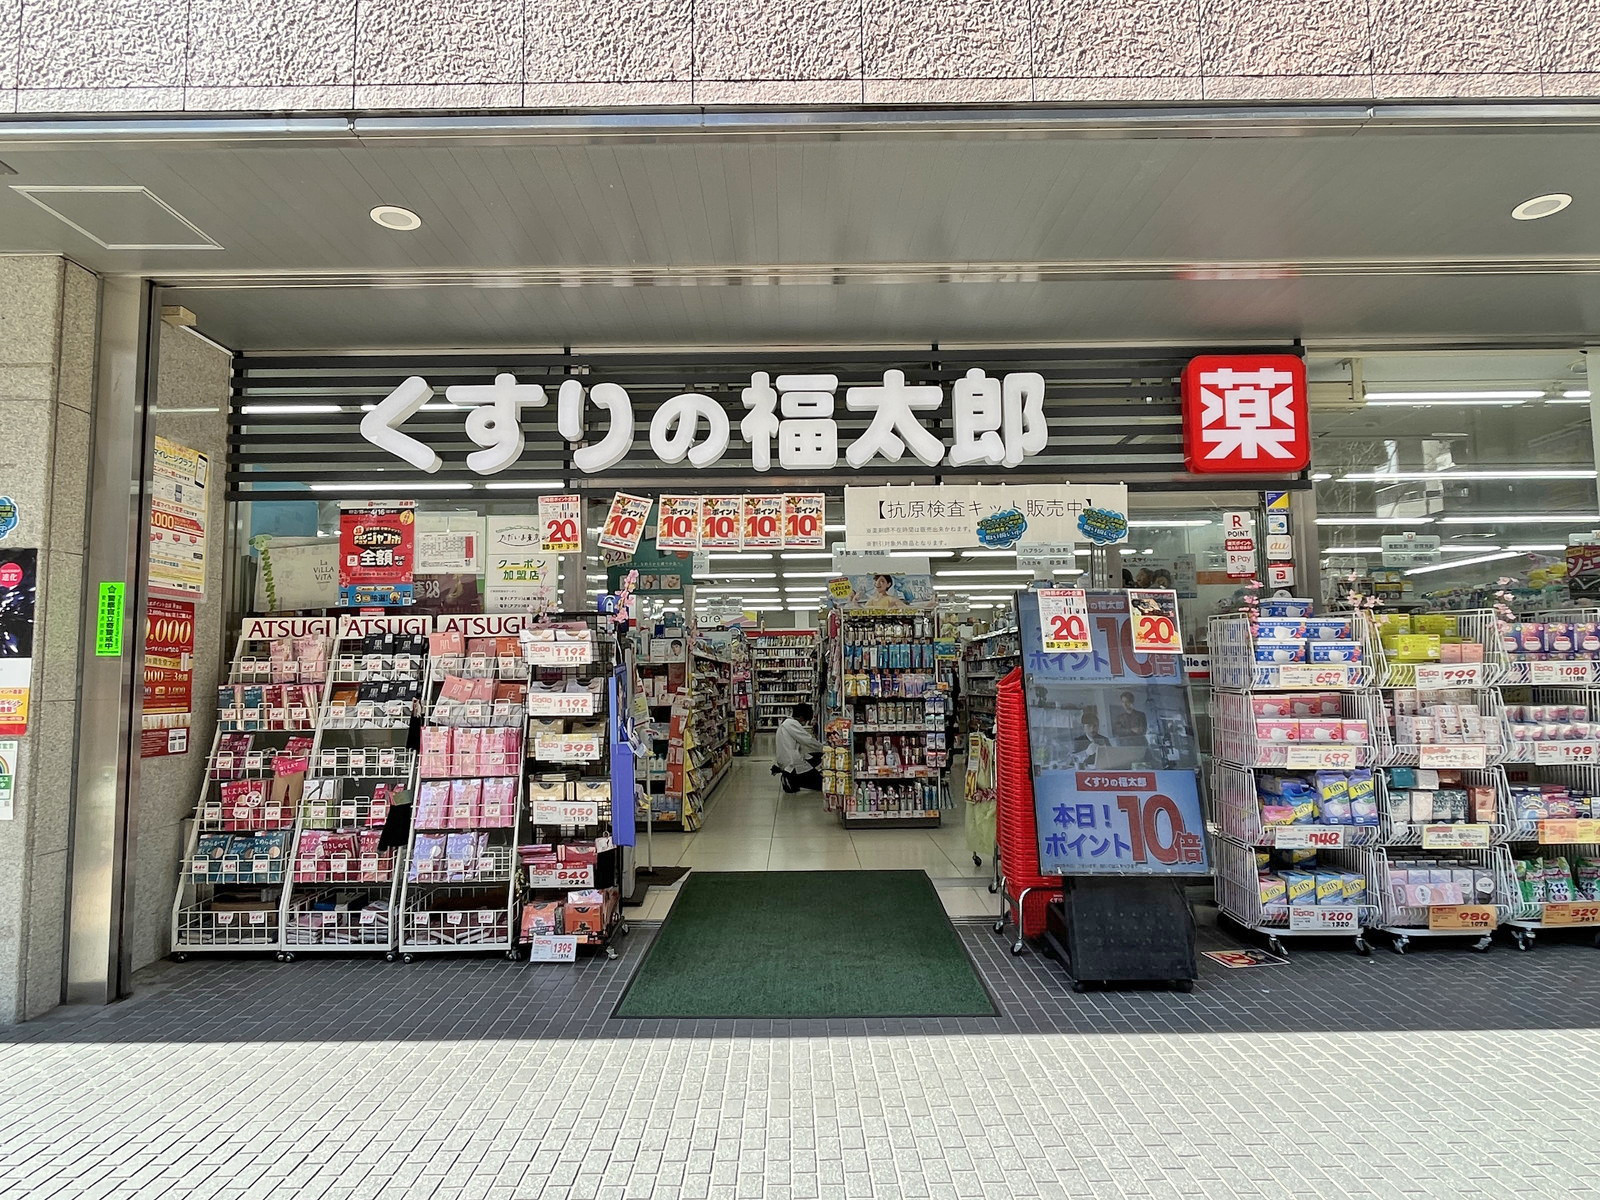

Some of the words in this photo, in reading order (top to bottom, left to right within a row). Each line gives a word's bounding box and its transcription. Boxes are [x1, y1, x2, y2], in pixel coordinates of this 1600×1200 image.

[1199, 367, 1296, 459] 薬
[360, 368, 1049, 474] くすりの福太郎
[878, 498, 1092, 520] 【抗原検査キット販売中】
[1270, 542, 1289, 550] au
[360, 549, 394, 567] 全額
[498, 559, 546, 569] クーポン
[1238, 555, 1251, 563] Pay
[503, 570, 540, 581] 加盟店
[248, 620, 331, 638] ATSUGI
[345, 618, 427, 637] ATSUGI
[444, 617, 530, 638] ATSUGI
[1140, 616, 1175, 644] 20
[1028, 651, 1110, 673] ポイント
[1316, 672, 1342, 682] 699
[1444, 669, 1477, 680] 799
[1558, 666, 1588, 676] 1080
[1324, 754, 1350, 764] 699
[1084, 776, 1148, 788] くすりの福太郎
[1327, 781, 1348, 794] Fitty
[1354, 781, 1372, 794] Fitty
[562, 806, 594, 816] 1050
[1052, 802, 1113, 829] 本日!
[1293, 804, 1309, 816] Fitty
[254, 838, 280, 846] なめらかで
[1044, 832, 1131, 858] ポイント
[1309, 832, 1340, 846] 748
[557, 870, 590, 880] 840
[1264, 886, 1282, 898] Fitty
[1292, 881, 1310, 894] Fitty
[1321, 881, 1338, 894] Fitty
[1344, 881, 1362, 894] Fitty
[1321, 912, 1354, 921] 1200
[1460, 912, 1490, 920] 980
[1572, 908, 1598, 917] 329
[554, 942, 572, 954] 1395
